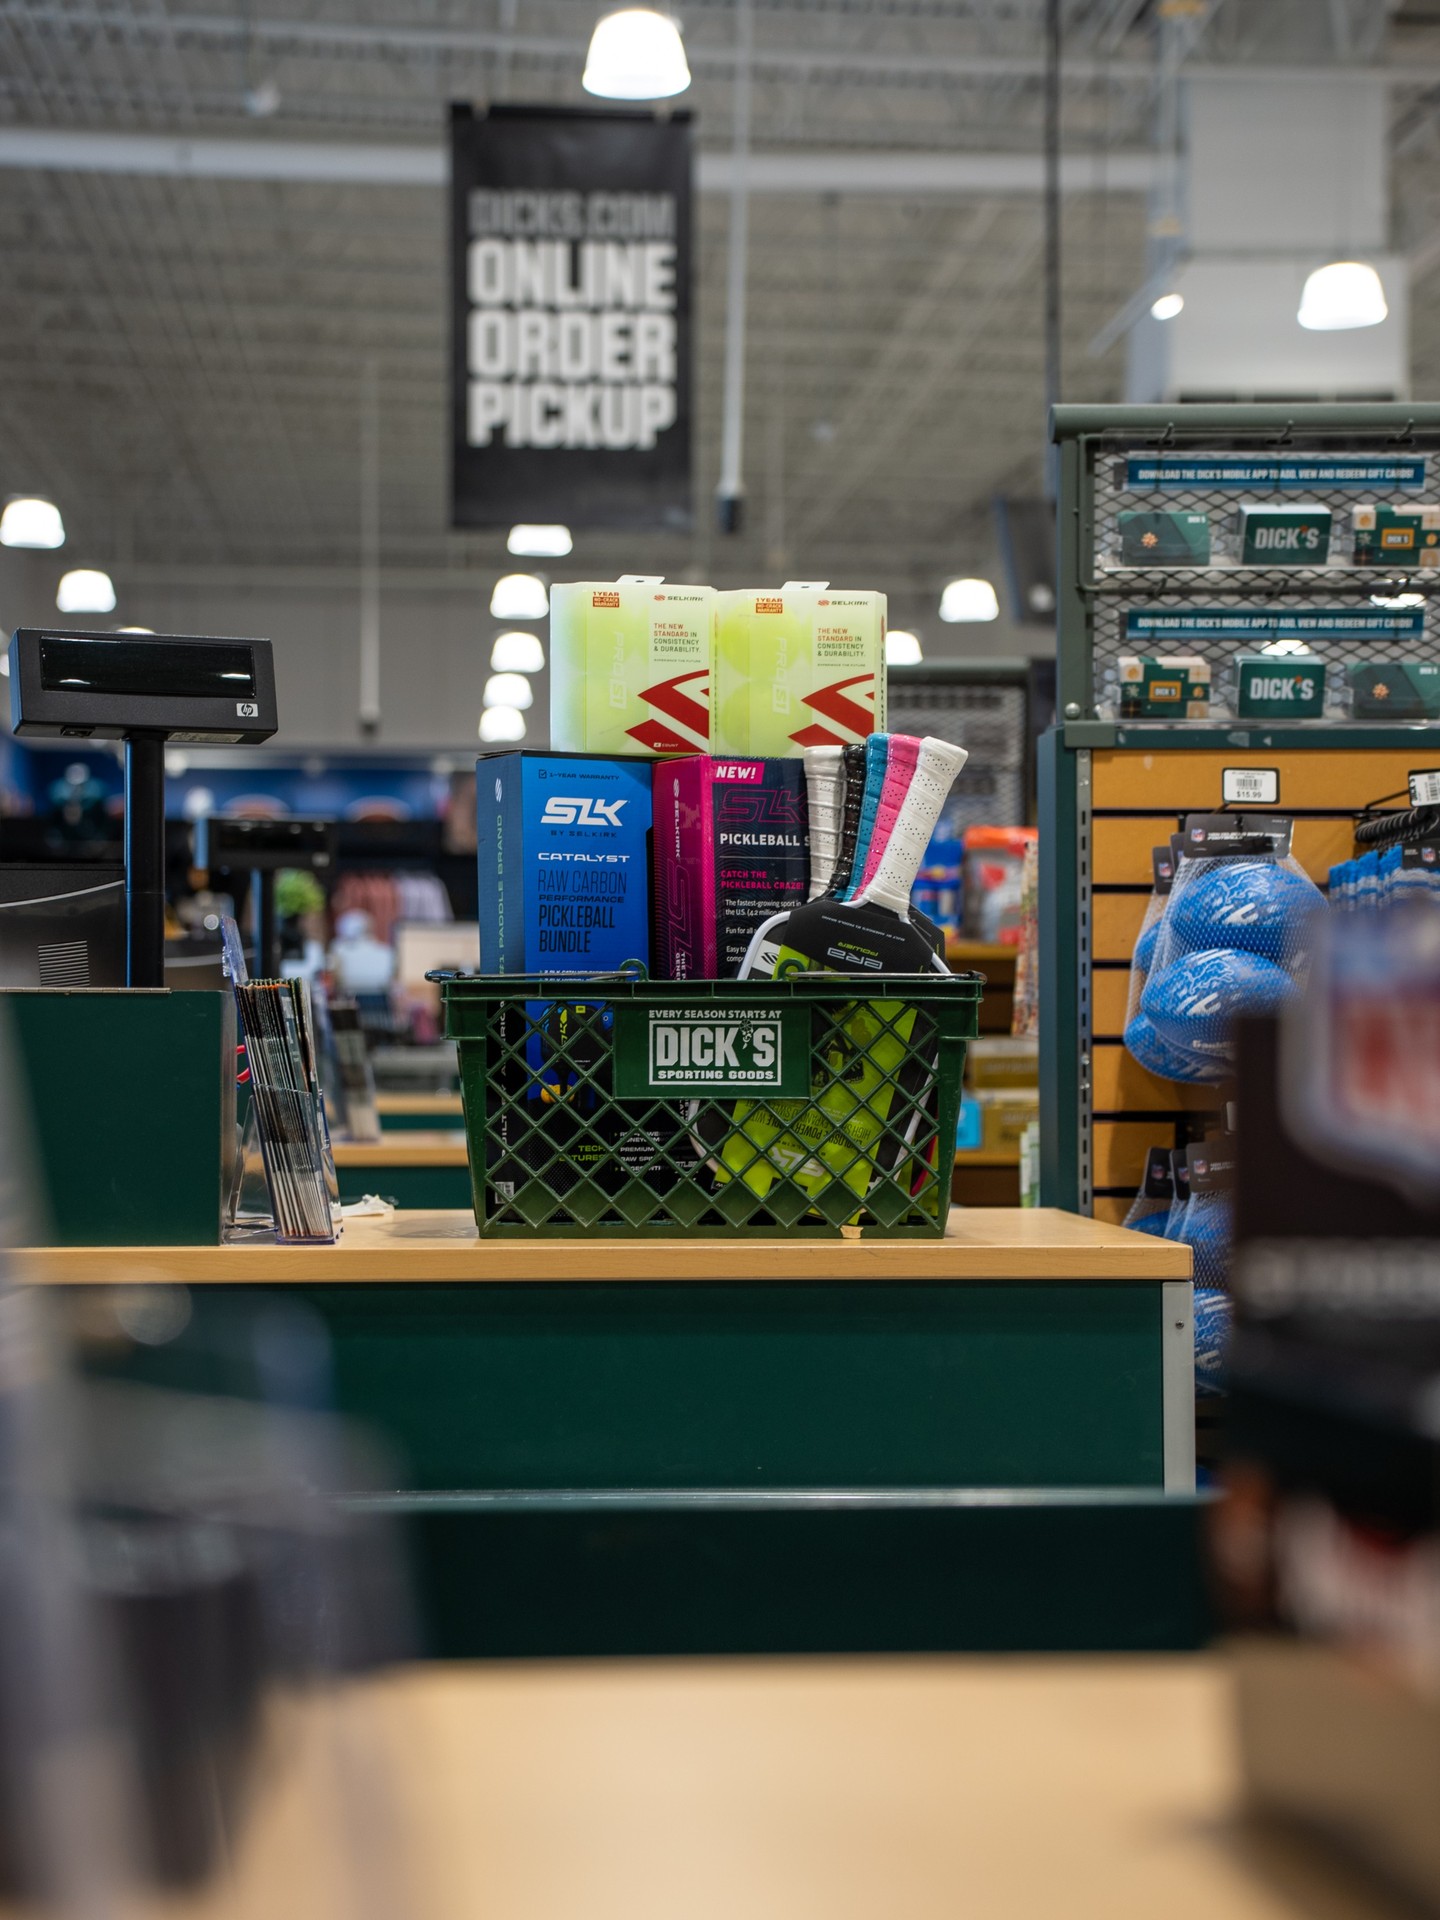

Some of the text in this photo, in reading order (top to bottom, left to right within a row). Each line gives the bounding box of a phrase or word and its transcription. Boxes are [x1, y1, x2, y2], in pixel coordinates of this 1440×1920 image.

[468, 190, 676, 237] DICKS.COM
[467, 241, 677, 308] ONLINE
[467, 309, 676, 382] ORDER
[467, 383, 677, 450] PICKUP
[1138, 469, 1180, 480] DOWNLOAD
[1182, 469, 1195, 480] THE
[1197, 469, 1221, 480] DICK'S
[1252, 469, 1268, 480] APP
[1318, 468, 1334, 479] AND
[1254, 525, 1319, 550] DICK'S
[1137, 618, 1180, 628] DOWNLOAD
[1181, 618, 1194, 628] THE
[1196, 618, 1220, 628] DICK'S
[1251, 618, 1268, 628] APP
[1317, 618, 1334, 628] AND
[654, 630, 689, 638] STANDARD
[654, 638, 699, 646] CONSISTENCY
[1250, 676, 1315, 701] DICK'S
[549, 770, 577, 778] 1-YEAR
[716, 766, 756, 779] NEW!
[540, 797, 629, 827] SLK
[718, 789, 808, 824] SLK
[719, 833, 801, 846] PICKLEBALL
[538, 853, 631, 863] CATALYST
[720, 870, 767, 879] CATCH THE
[538, 869, 627, 894] RAW CARBON
[721, 881, 804, 890] PICKLEBALL CRAZE!
[539, 894, 625, 903] PERFORMANCE
[737, 899, 780, 908] fastest-growing
[539, 904, 615, 928] PICKLEBALL
[539, 929, 592, 953] BUNDLE
[649, 1010, 782, 1019] EVERY SEASON STARTS AT
[656, 1026, 775, 1067] DICK'S
[658, 1070, 723, 1080] SPORTING
[795, 1123, 823, 1140] POWER
